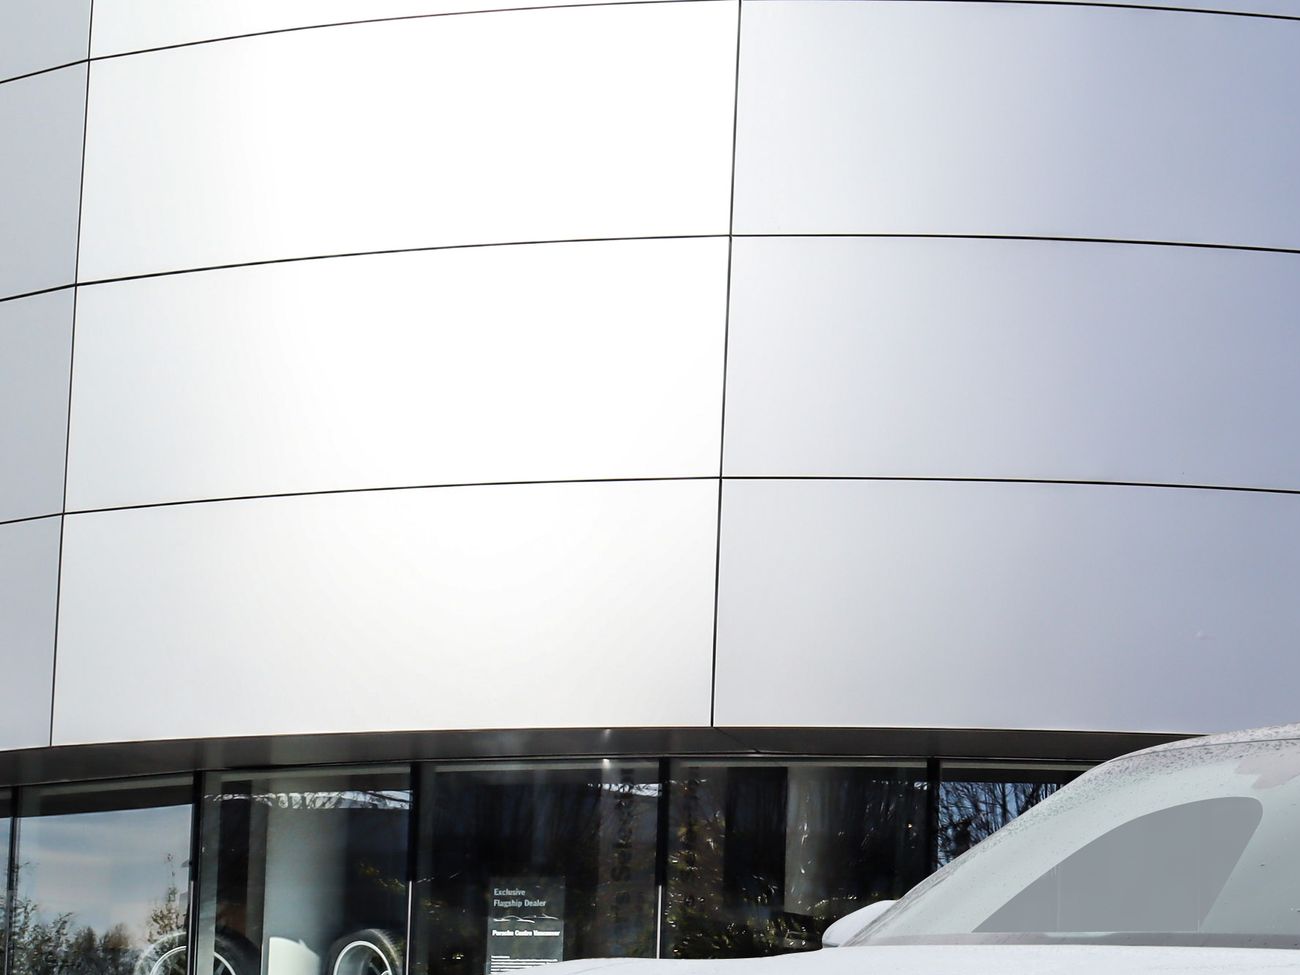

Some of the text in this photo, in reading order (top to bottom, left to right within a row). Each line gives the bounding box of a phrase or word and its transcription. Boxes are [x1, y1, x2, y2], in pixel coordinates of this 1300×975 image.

[493, 888, 526, 896] Exclusive
[493, 899, 546, 908] Flagship Dealer
